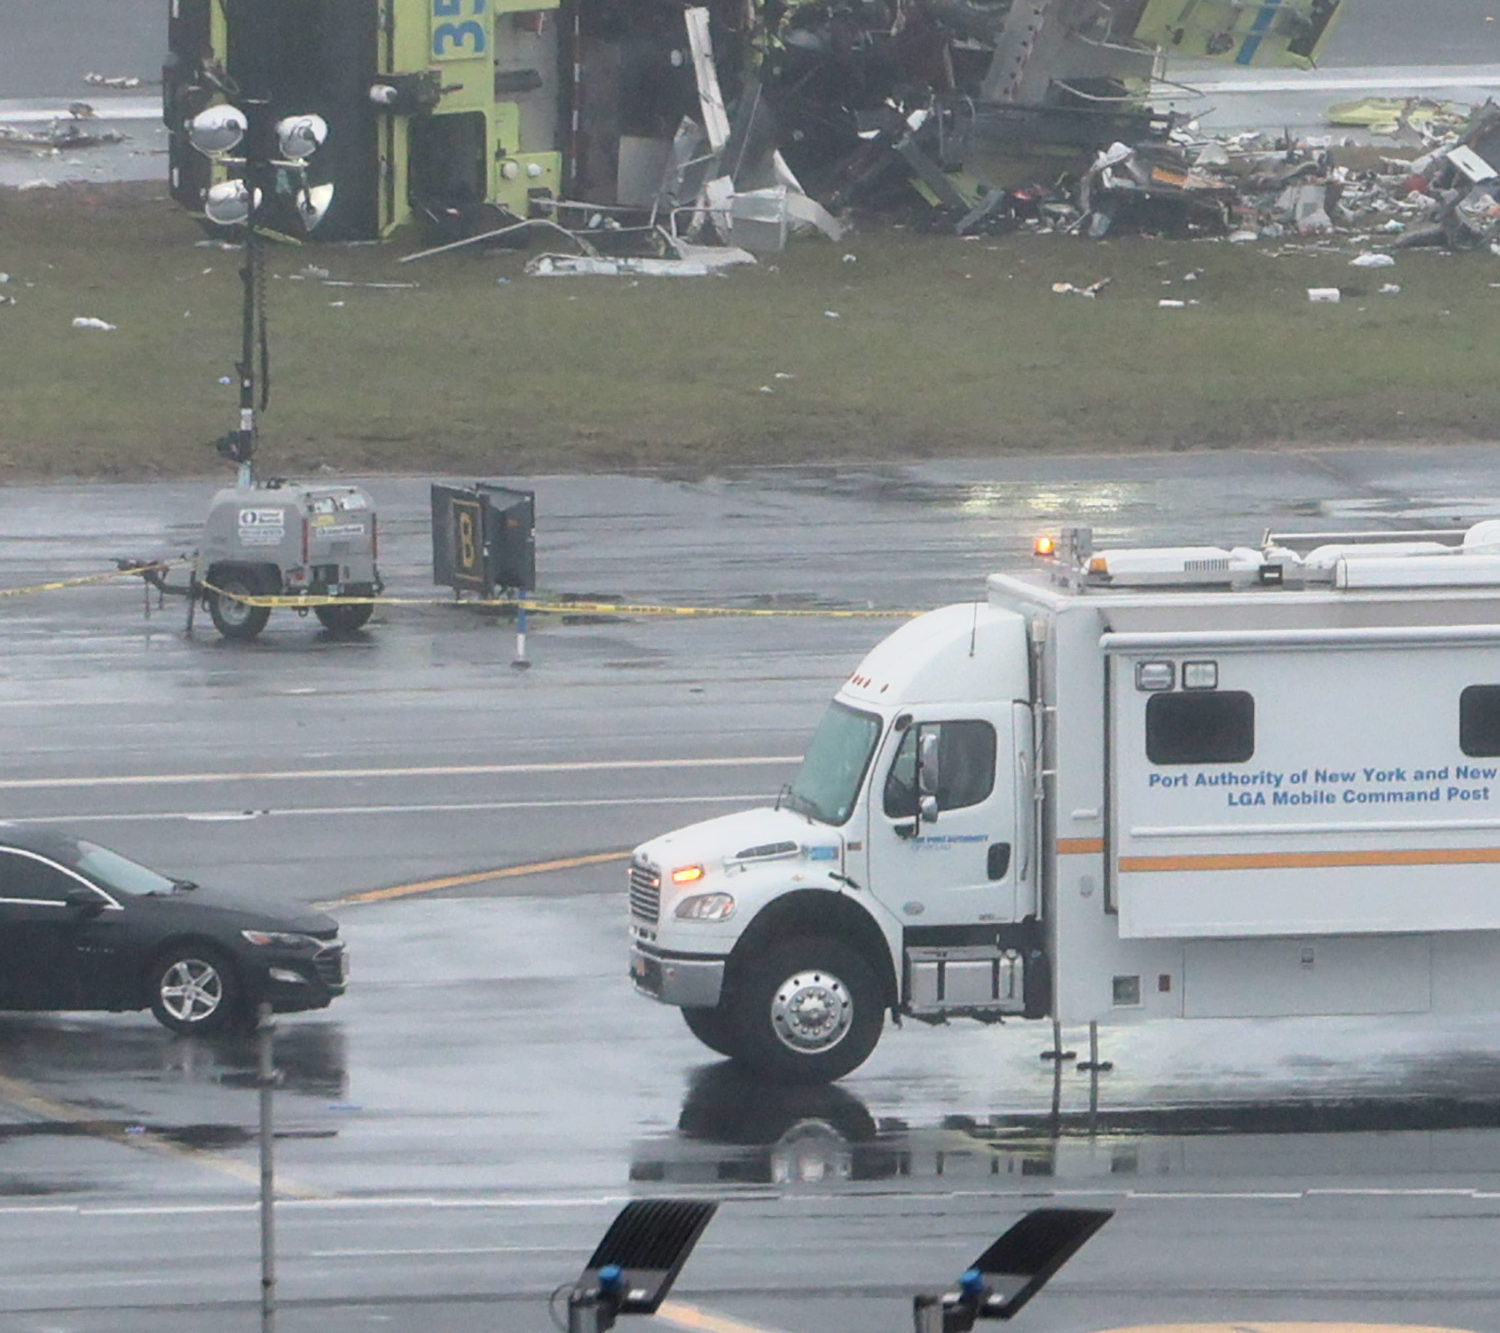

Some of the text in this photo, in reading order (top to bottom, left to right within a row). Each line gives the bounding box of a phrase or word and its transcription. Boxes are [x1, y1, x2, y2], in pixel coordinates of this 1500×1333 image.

[1149, 773, 1188, 787] Port
[1195, 770, 1284, 788] Authority
[1290, 769, 1308, 785] of
[1314, 768, 1356, 783] New
[1363, 768, 1407, 782] York
[1413, 766, 1449, 781] and
[1456, 765, 1498, 780] New
[1228, 786, 1490, 806] LGA Mobile Command Post
